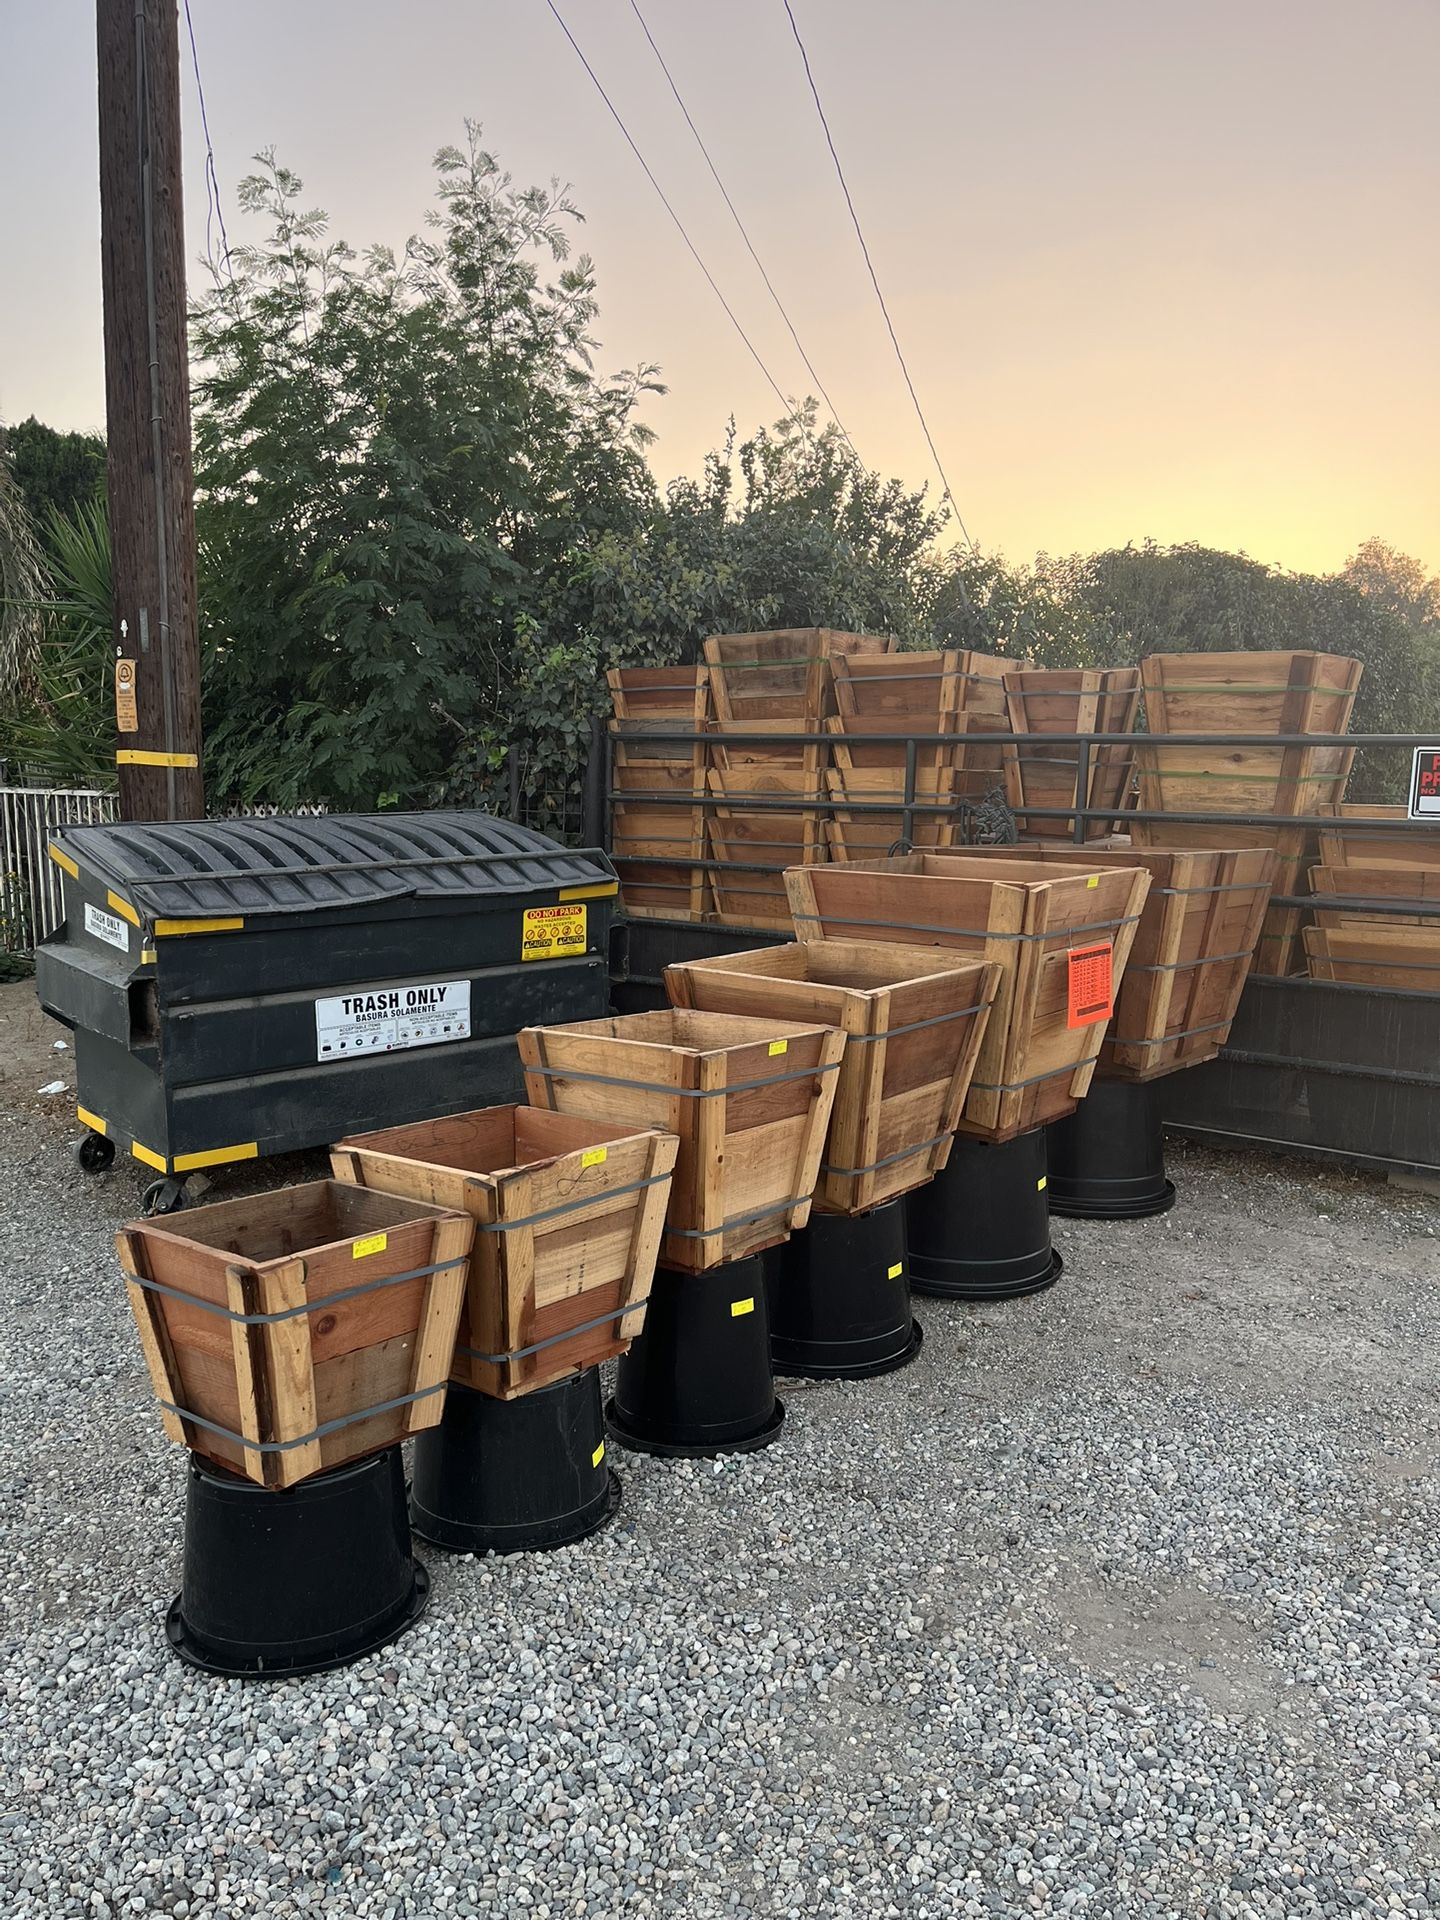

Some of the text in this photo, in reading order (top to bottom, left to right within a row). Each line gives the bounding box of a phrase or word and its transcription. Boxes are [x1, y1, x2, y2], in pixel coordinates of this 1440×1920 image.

[92, 909, 120, 931] TRASH ONLY
[530, 907, 580, 919] DO NOT PARK
[342, 987, 447, 1015] TRASH ONLY
[356, 1004, 436, 1023] BASURA SOLAMENTE
